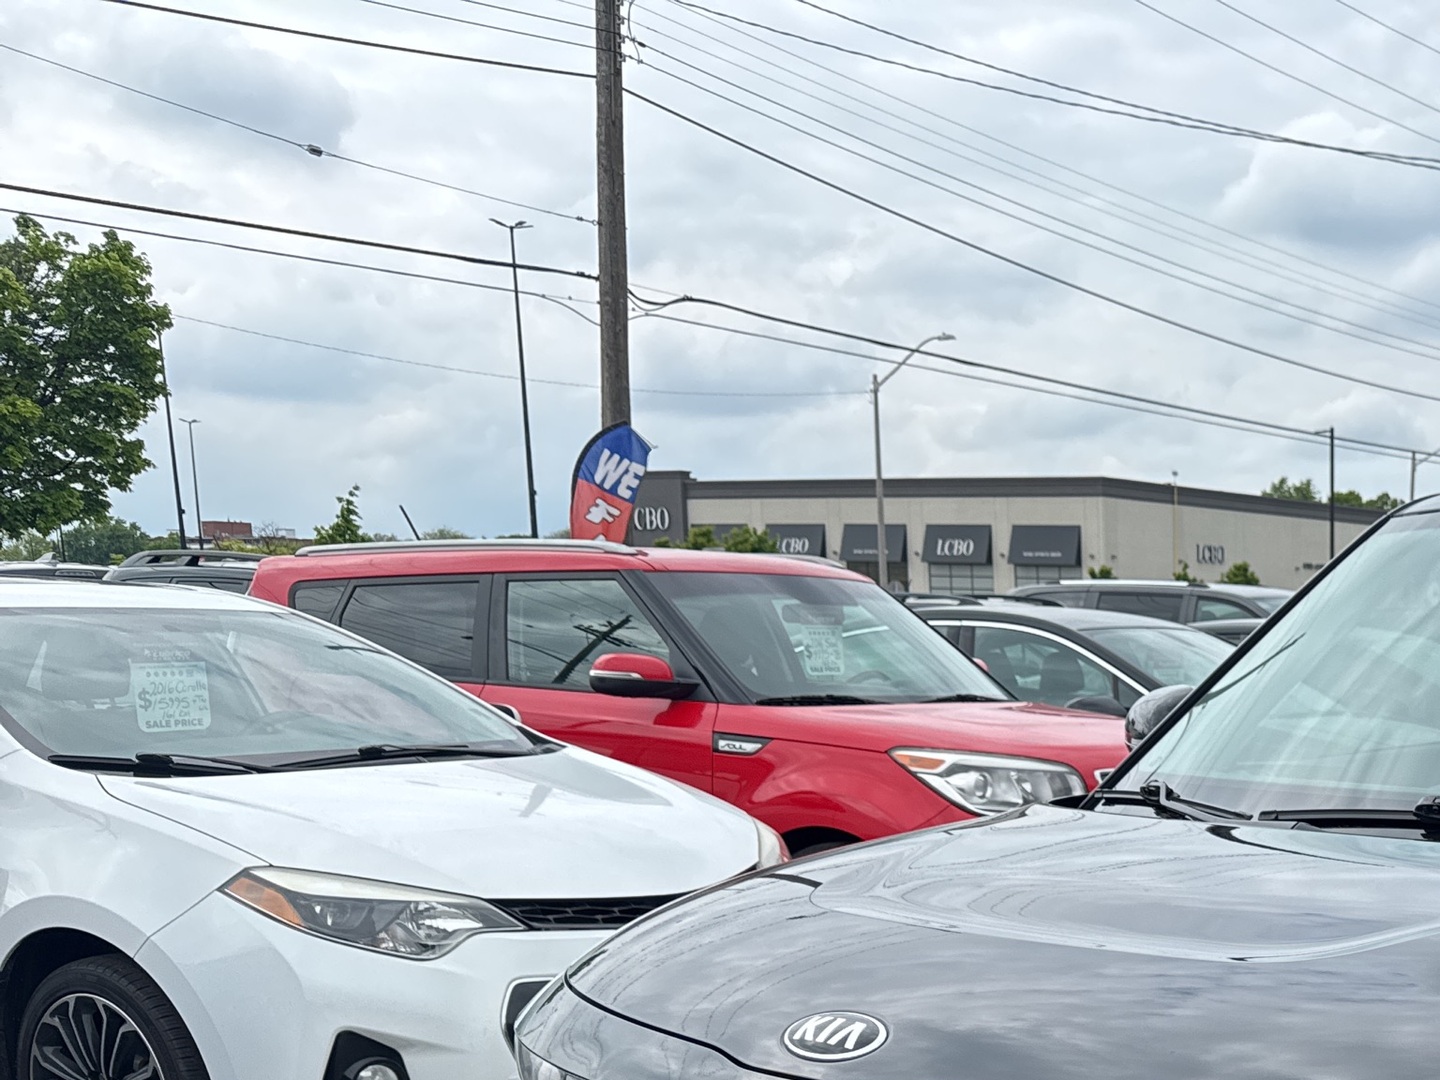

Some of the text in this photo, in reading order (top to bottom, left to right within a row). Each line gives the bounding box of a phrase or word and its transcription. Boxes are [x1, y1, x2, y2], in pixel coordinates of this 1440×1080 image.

[594, 447, 646, 499] WE
[634, 506, 670, 531] CBO
[936, 538, 975, 557] LCBO
[1197, 544, 1225, 565] LCBO
[149, 681, 175, 697] 2016
[145, 718, 204, 729] SALE PRICE
[792, 1016, 867, 1050] KIA
